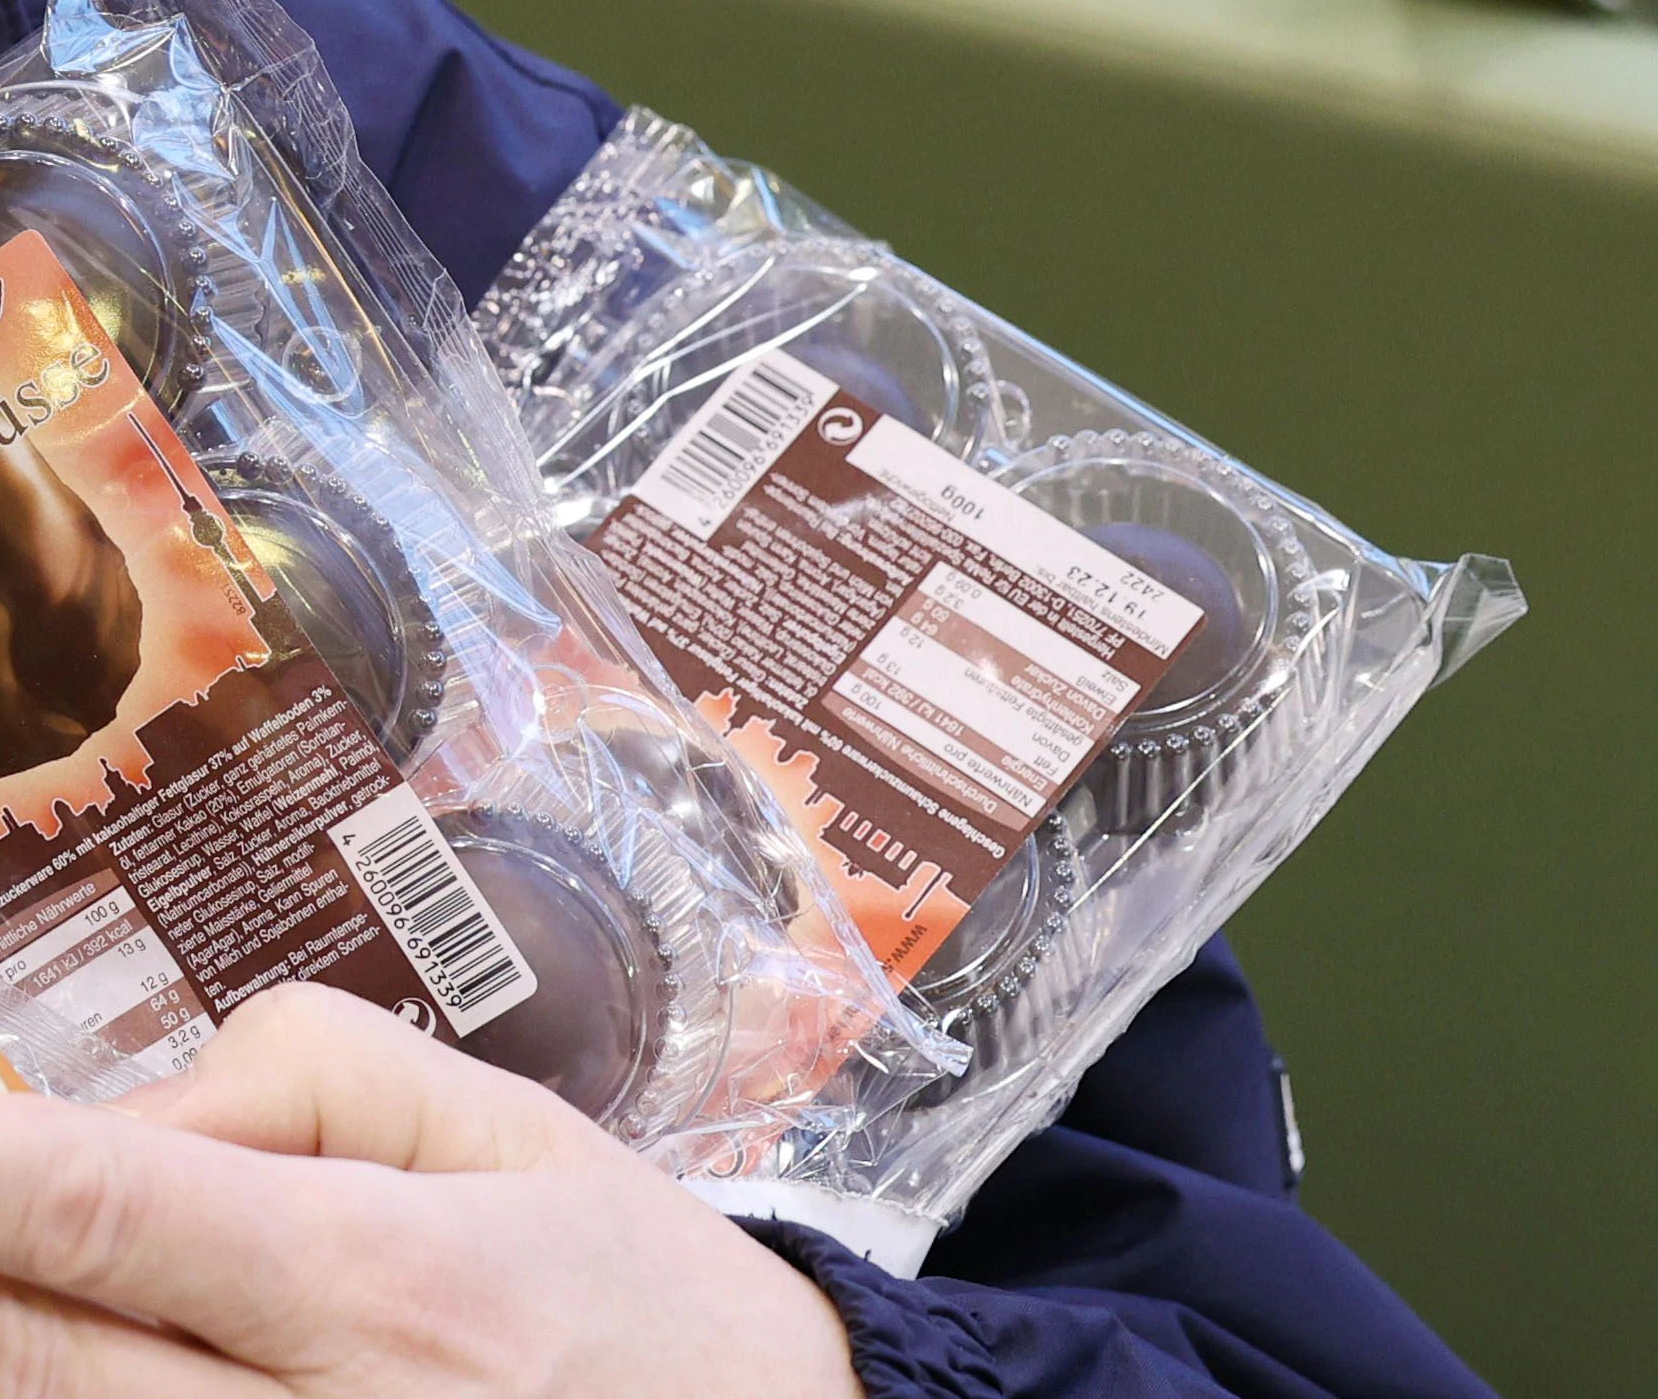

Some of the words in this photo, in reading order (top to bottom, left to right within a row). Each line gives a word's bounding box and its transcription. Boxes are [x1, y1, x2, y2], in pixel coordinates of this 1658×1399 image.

[938, 482, 987, 522] 100g
[849, 681, 863, 695] g
[857, 688, 883, 711] 100
[1008, 671, 1097, 735] Kohlenhydrate
[1021, 660, 1068, 697] Zucker
[1074, 673, 1117, 707] Eiweiß
[1099, 668, 1129, 694] Salz
[1022, 702, 1085, 750] gesättigte
[1063, 687, 1106, 721] Davon
[941, 739, 968, 763] pro
[999, 751, 1049, 791] Energie
[1029, 730, 1071, 764] Davon
[1032, 754, 1059, 777] Fett
[50, 847, 78, 872] 60%
[73, 835, 96, 856] mit
[90, 793, 163, 847] kakaohaltiger
[157, 761, 212, 805] Fettglasur
[206, 747, 233, 771] 37%
[229, 735, 252, 756] auf
[247, 694, 315, 744] Waffelboden
[310, 683, 333, 704] 3%
[108, 819, 155, 857] Zutaten:
[150, 799, 186, 829] Glasur
[181, 774, 226, 811] (Zucker,
[221, 761, 251, 786] ganz
[295, 695, 350, 737] Palmkern-
[131, 825, 178, 863] fettarmer
[174, 807, 208, 835] Kakao
[204, 786, 241, 818] (20%),
[235, 748, 302, 798] Emulgatoren
[295, 717, 349, 758] (Sorbitan-
[964, 756, 1034, 808] Nährwerte
[127, 847, 178, 887] tristearat,
[172, 817, 225, 858] Lecithine),
[219, 775, 291, 828] Kokosraspeln,
[285, 749, 330, 785] Aroma),
[325, 726, 368, 761] Zucker,
[136, 849, 207, 902] Glukosesirup,
[201, 824, 245, 860] Wasser,
[239, 804, 275, 834] Waffel
[270, 762, 343, 816] (Weizenmehl,
[338, 738, 381, 773] Palmöl,
[250, 795, 354, 869] Hühnereiklarpulver,
[348, 771, 395, 808] getrock-
[146, 861, 218, 916] Eigelbpulver,
[212, 846, 242, 873] Salz,
[236, 823, 277, 857] Zucker,
[272, 801, 312, 834] Aroma,
[306, 755, 382, 811] Backtriebmittel
[35, 878, 97, 926] Nährwerte
[166, 916, 196, 941] neter
[191, 875, 260, 927] Glukosesirup,
[254, 859, 285, 886] Salz,
[279, 838, 317, 869] modifi-
[175, 929, 207, 955] zierte
[202, 894, 262, 939] Maisstärke,
[256, 860, 313, 904] Geliermittel
[4, 958, 29, 981] pro
[83, 903, 109, 927] 100
[106, 899, 121, 915] g
[184, 926, 245, 973] (AgarAgar),
[239, 904, 278, 935] Aroma.
[273, 887, 304, 913] Kann
[299, 865, 340, 899] Spuren
[195, 964, 218, 984] von
[213, 946, 244, 972] Milch
[239, 934, 262, 955] und
[258, 899, 318, 946] Sojabohnen
[312, 877, 351, 910] enthal-
[338, 829, 359, 848] 4
[352, 854, 412, 932] 260096
[404, 933, 464, 1011] 691339
[31, 963, 63, 990] 1641
[82, 933, 109, 957] 392
[105, 917, 134, 943] kcal
[115, 940, 136, 960] 13
[132, 936, 147, 952] g
[211, 956, 293, 1016] Aufbewahrung:
[286, 945, 309, 966] Bei
[304, 906, 371, 958] Raumtempe-
[295, 946, 342, 983] direktem
[336, 920, 383, 957] Sonnen-
[139, 974, 159, 993] 12
[156, 971, 170, 986] g
[148, 992, 170, 1013] 64
[166, 988, 181, 1004] g
[203, 977, 227, 999] ten.
[158, 1009, 181, 1030] 50
[177, 1005, 192, 1021] g
